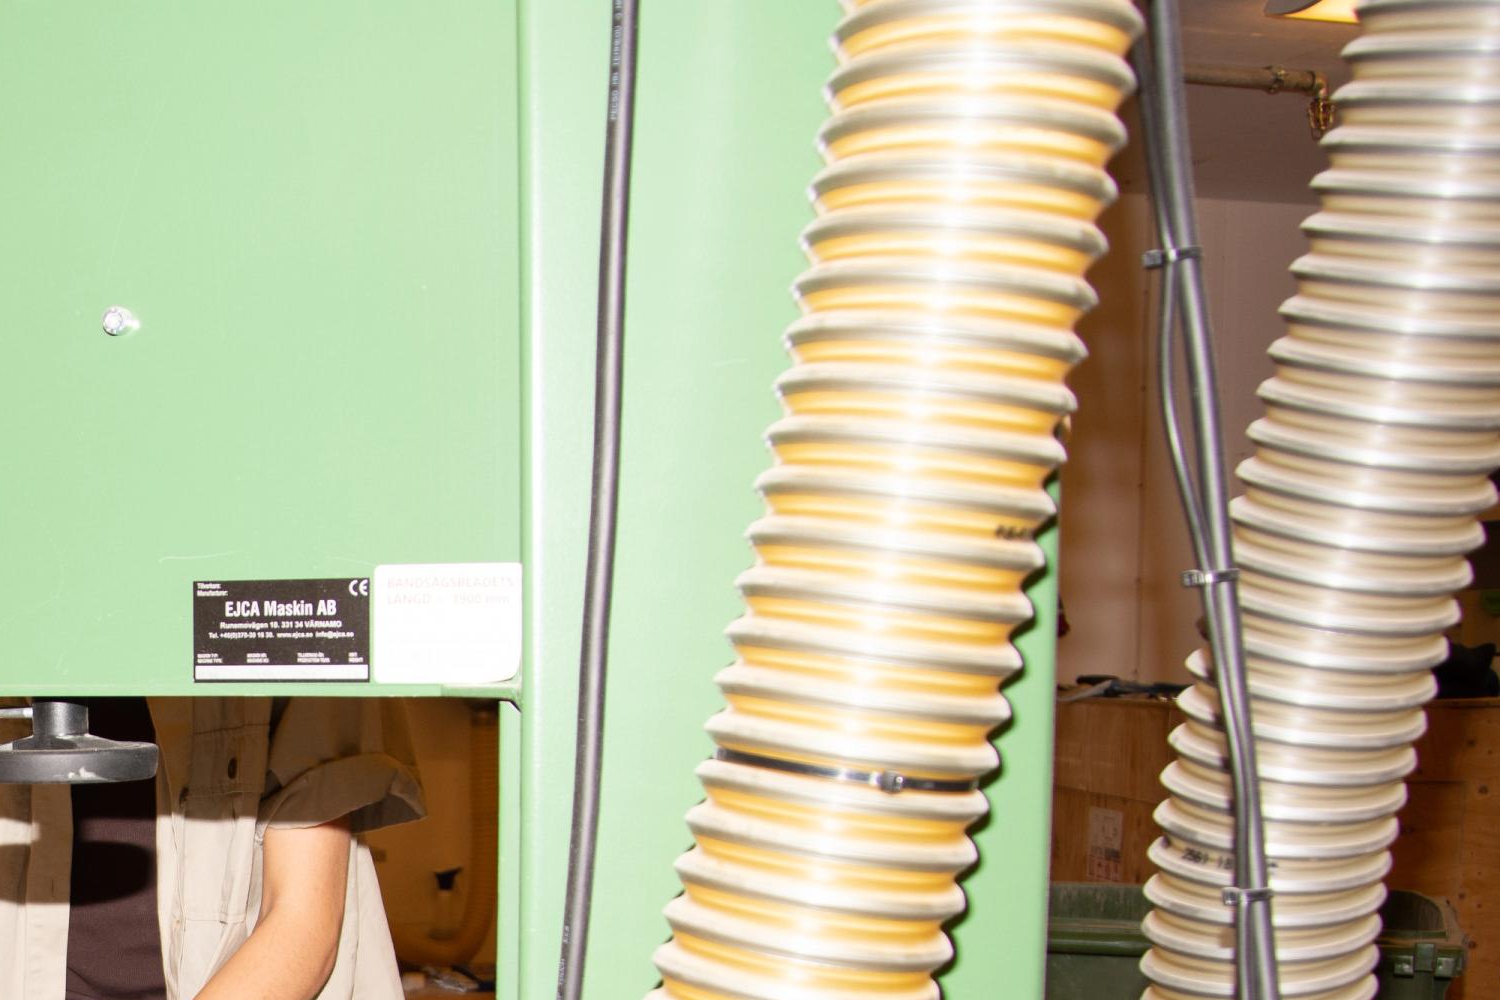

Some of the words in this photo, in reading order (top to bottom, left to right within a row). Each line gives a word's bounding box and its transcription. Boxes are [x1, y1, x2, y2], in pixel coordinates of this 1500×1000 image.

[225, 600, 260, 617] EJCA
[263, 600, 313, 616] Maskin
[316, 599, 337, 615] AB
